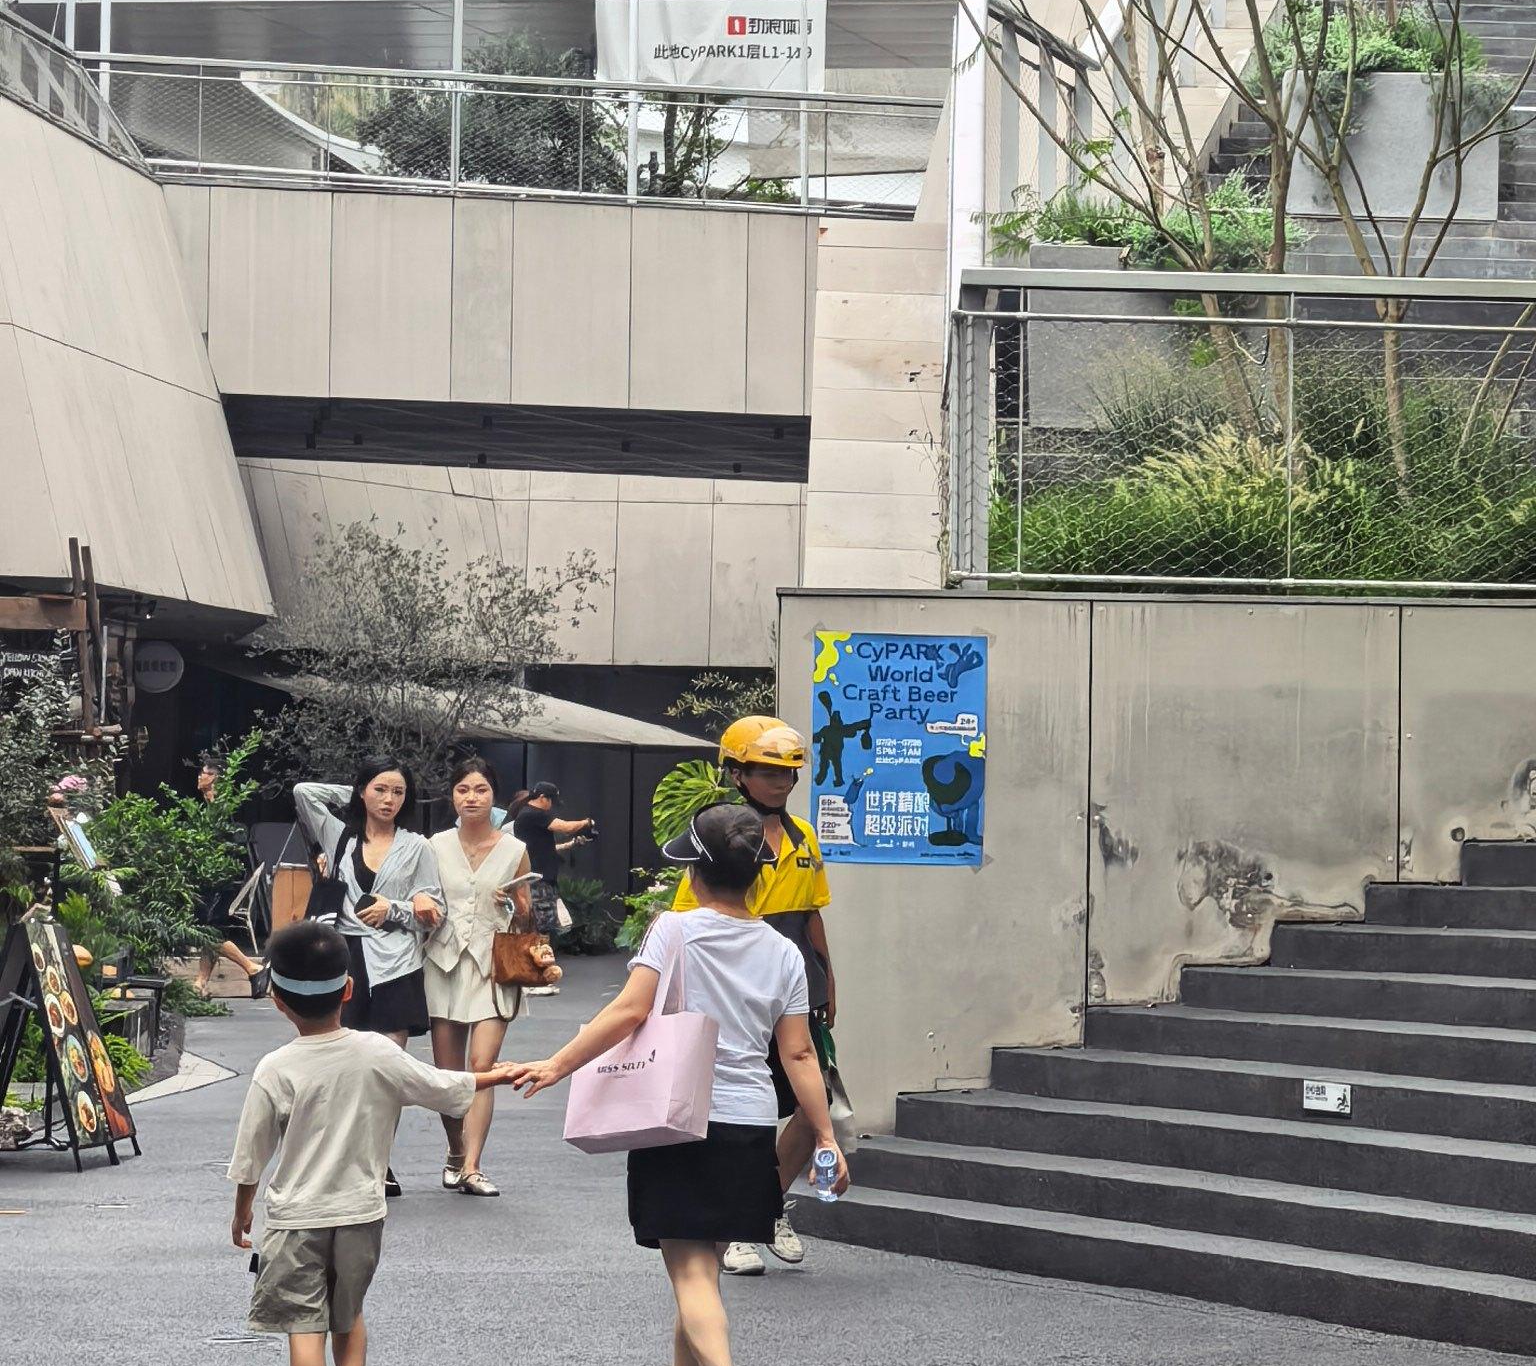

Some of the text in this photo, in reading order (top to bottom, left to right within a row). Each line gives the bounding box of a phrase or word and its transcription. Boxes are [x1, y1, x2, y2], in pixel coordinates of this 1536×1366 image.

[856, 641, 945, 663] CyPARK
[867, 664, 934, 683] World
[843, 683, 958, 703] Craft Beer
[869, 702, 930, 725] Party
[865, 790, 930, 813] 世界精酿
[864, 814, 929, 837] 超级派对
